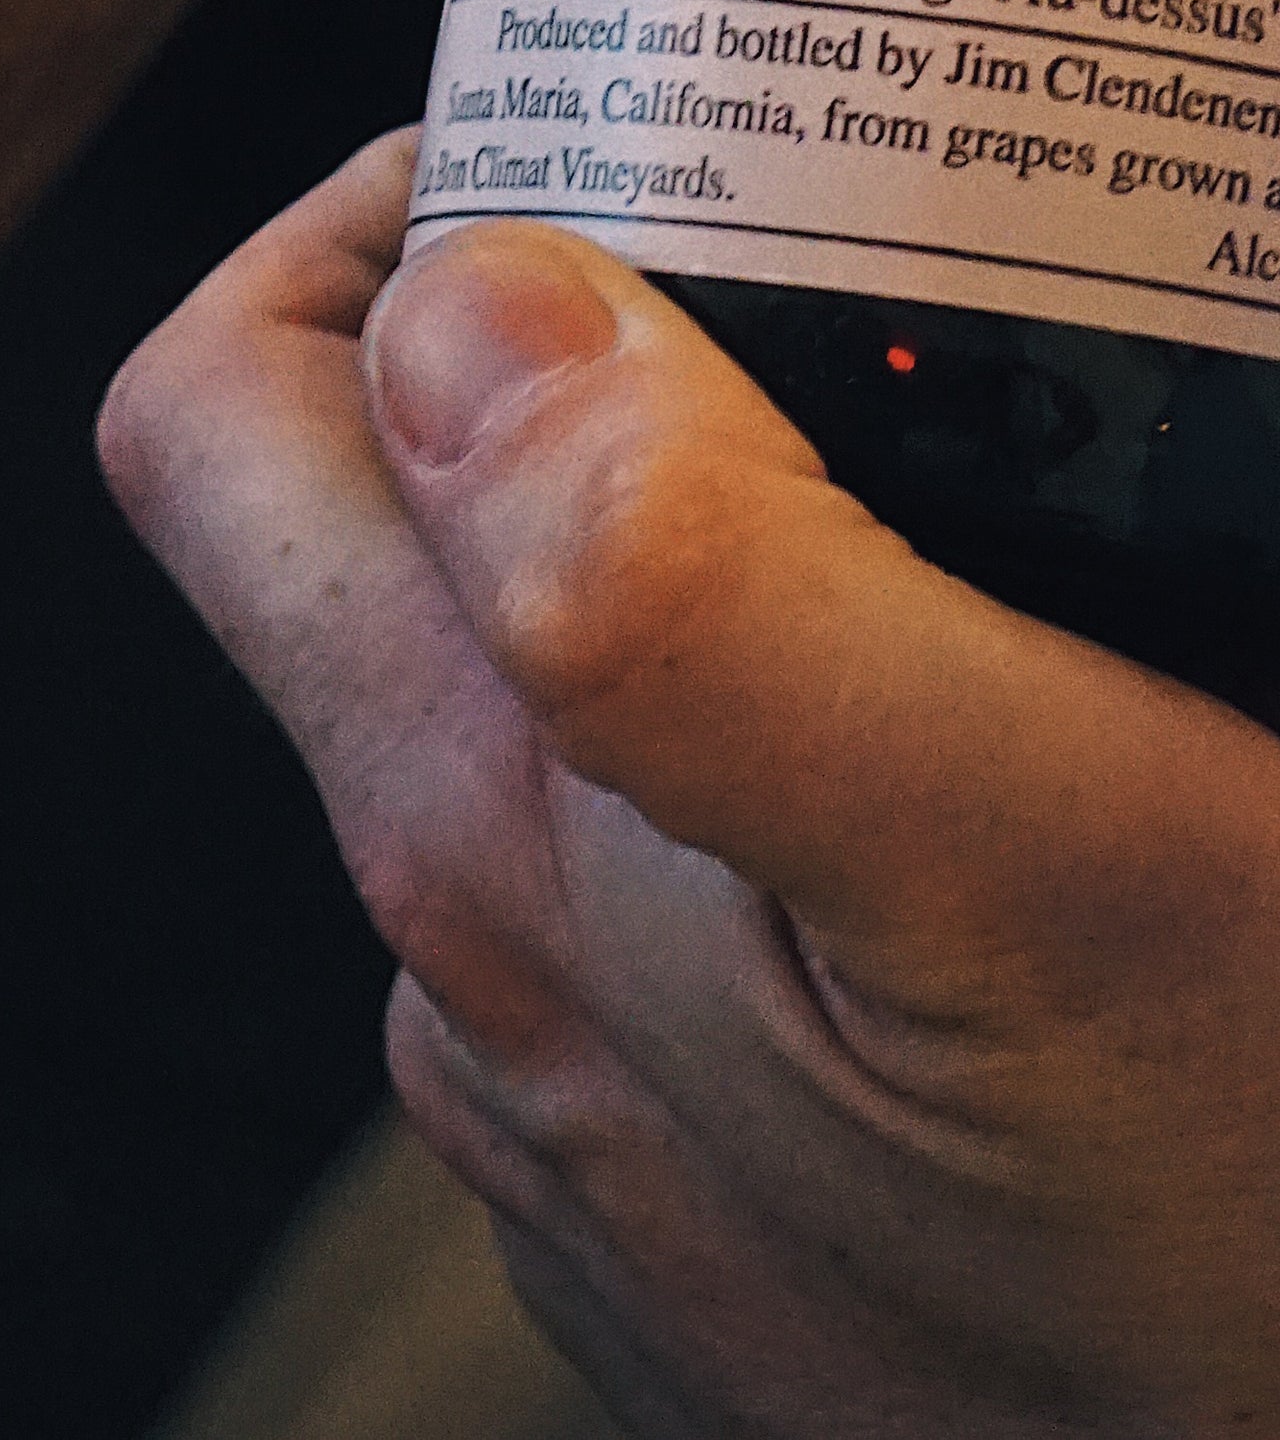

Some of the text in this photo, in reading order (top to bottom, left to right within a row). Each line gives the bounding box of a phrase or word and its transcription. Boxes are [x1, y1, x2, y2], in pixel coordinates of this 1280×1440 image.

[497, 6, 630, 54] Produced
[638, 11, 705, 56] and
[716, 14, 863, 72] bottled
[876, 30, 934, 91] by
[944, 41, 1031, 95] Jim
[471, 144, 551, 193] Climat
[561, 145, 737, 207] Vineyards.
[500, 76, 588, 126] Maria,
[601, 77, 806, 145] California,
[820, 97, 931, 151] from
[943, 124, 1097, 180] grapes
[1107, 148, 1253, 196] grown
